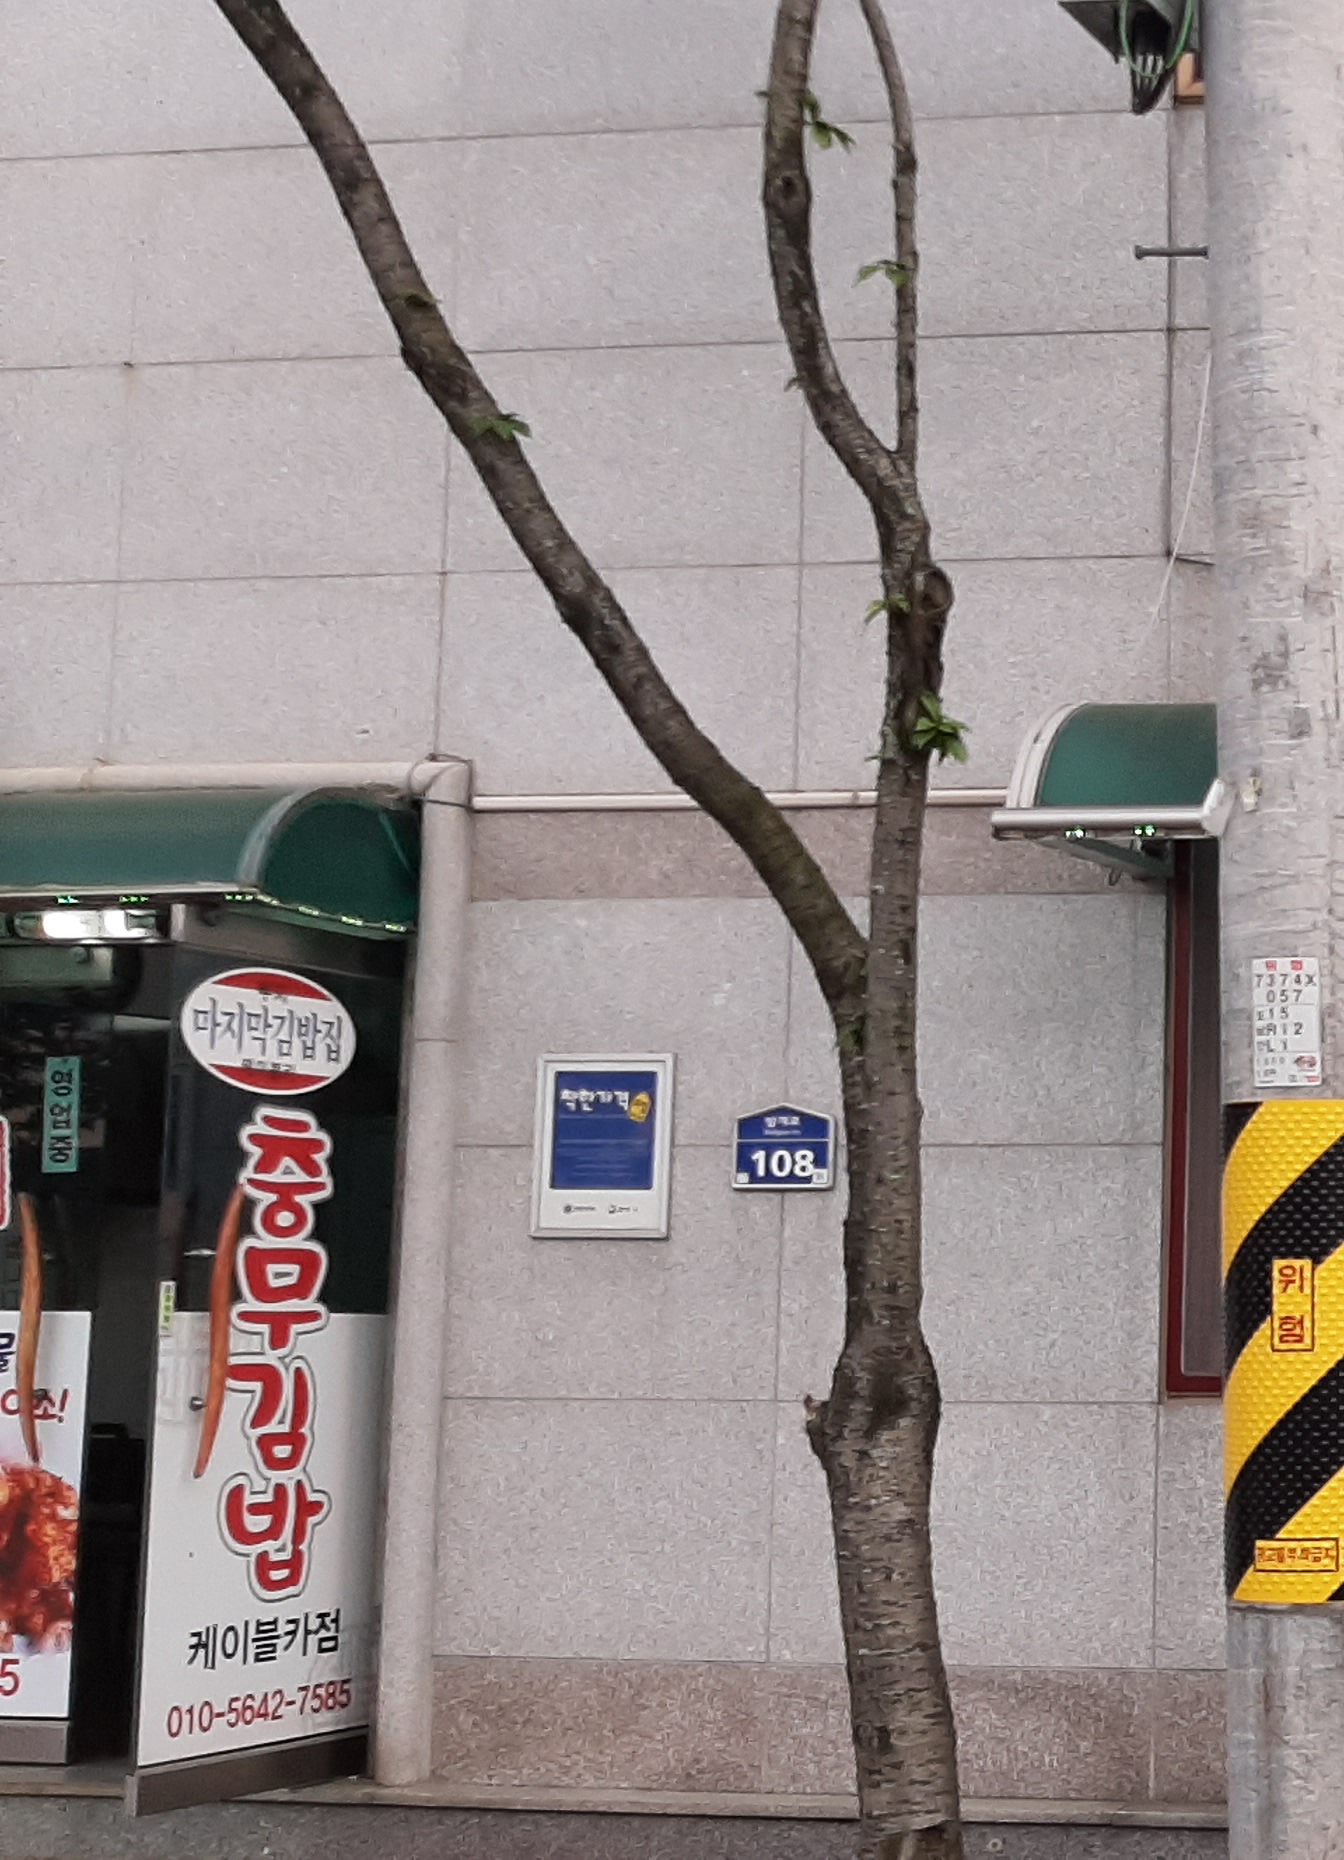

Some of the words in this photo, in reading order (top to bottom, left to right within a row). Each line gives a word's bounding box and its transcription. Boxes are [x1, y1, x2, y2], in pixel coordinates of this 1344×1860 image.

[192, 996, 343, 1065] 마지막김밥집
[751, 1148, 815, 1178] 108
[1278, 1264, 1305, 1344] 위험
[222, 1112, 328, 1596] 충무김밥
[186, 1607, 341, 1670] 케이블카점
[167, 1677, 353, 1738] 010-5642-7585
